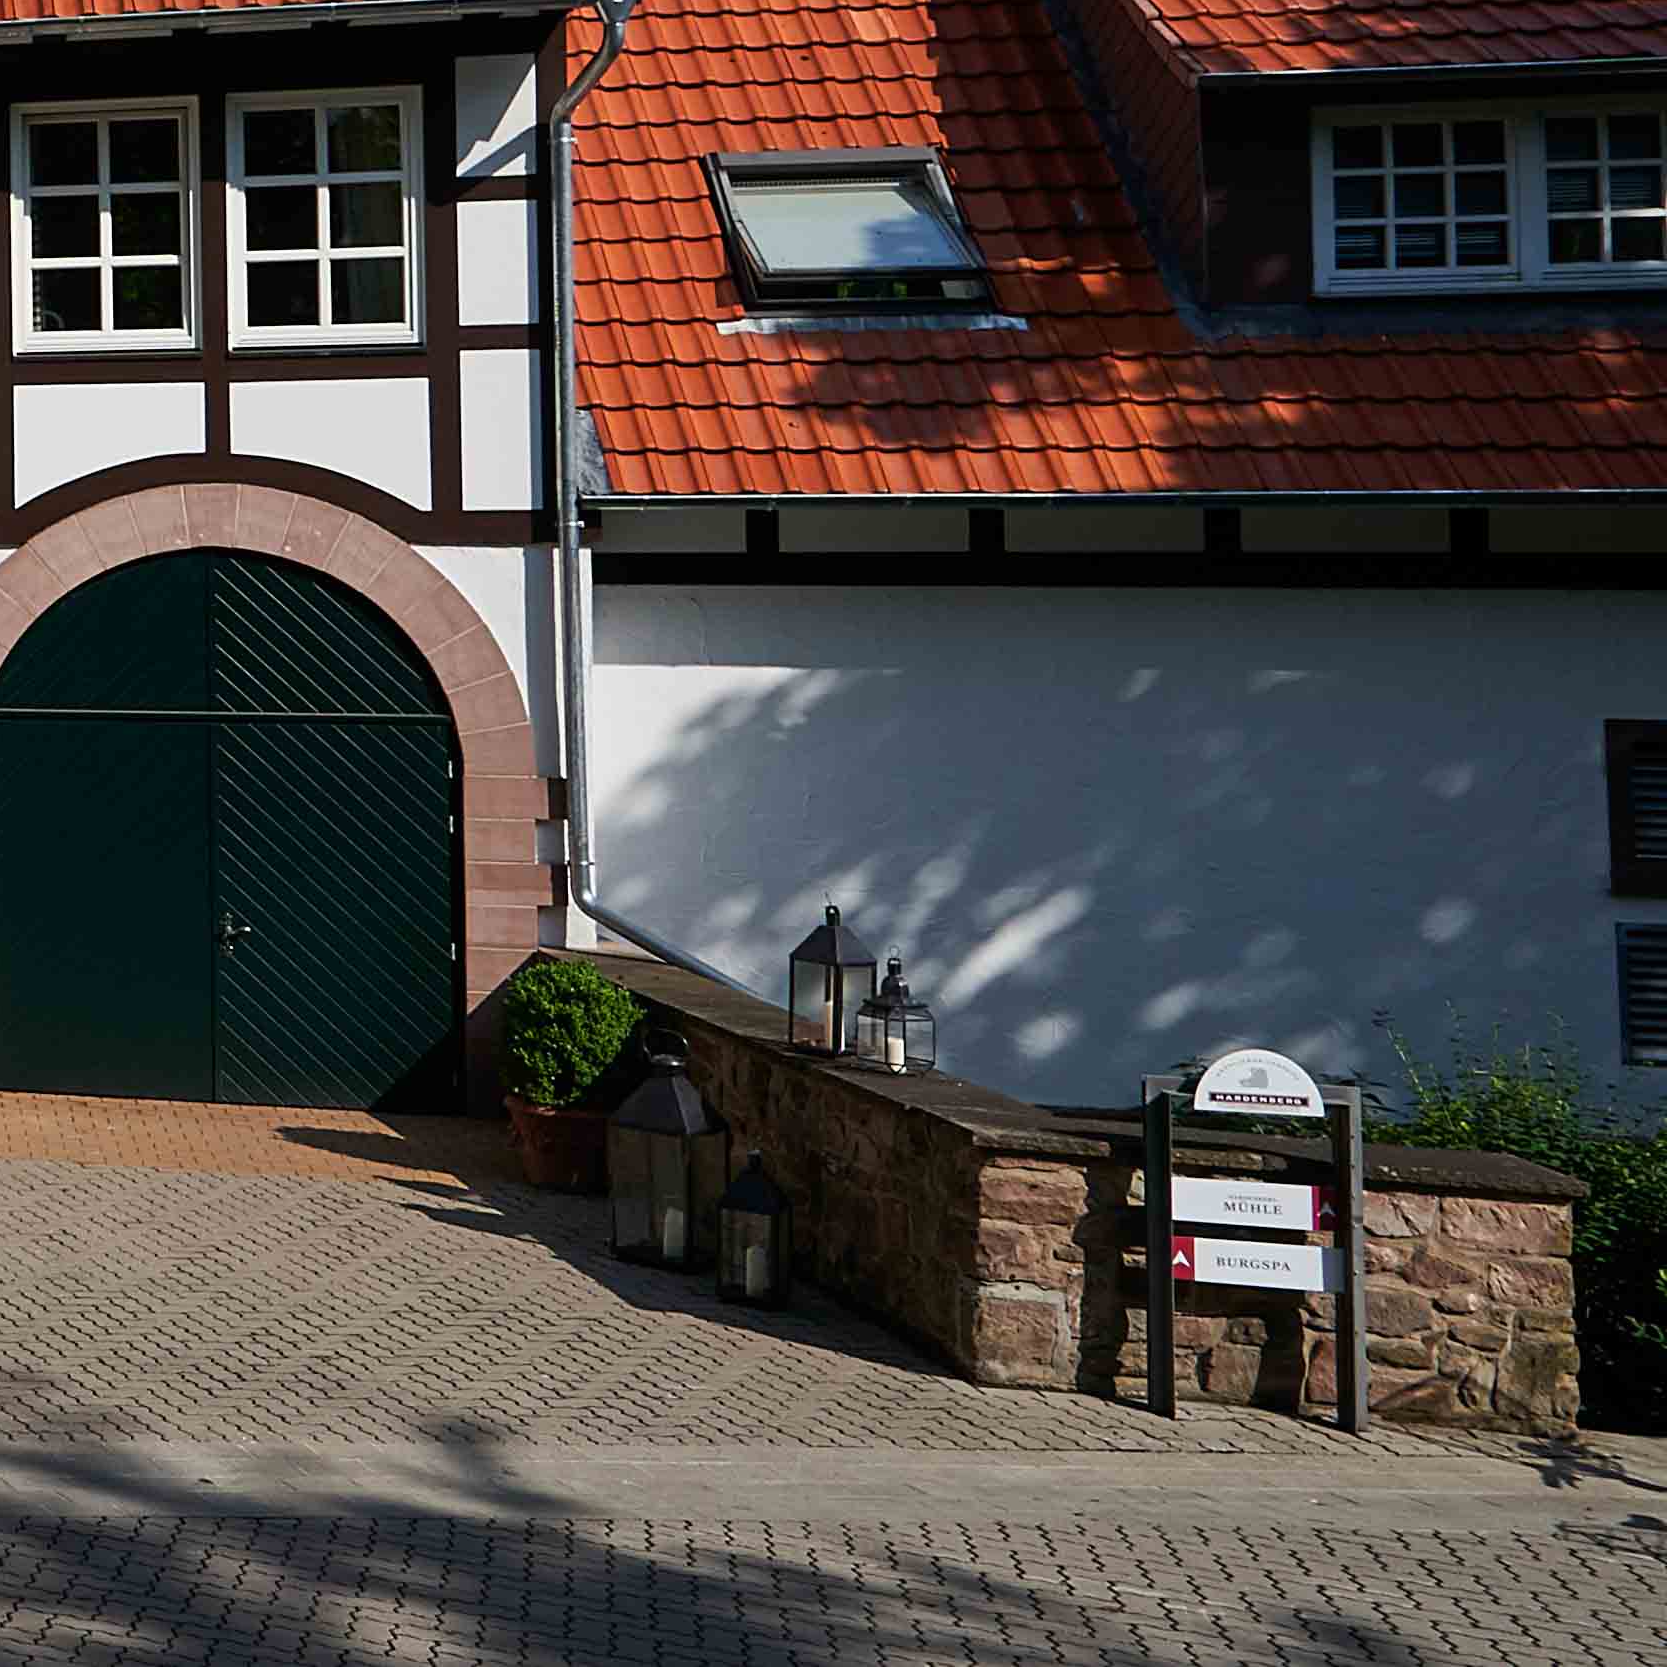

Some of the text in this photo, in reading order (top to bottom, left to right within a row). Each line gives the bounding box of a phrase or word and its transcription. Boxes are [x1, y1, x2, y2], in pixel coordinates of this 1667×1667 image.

[1214, 1094, 1303, 1105] HARDENBERG
[1223, 1200, 1284, 1216] MÜHLE
[1216, 1255, 1292, 1272] BURGSPA
